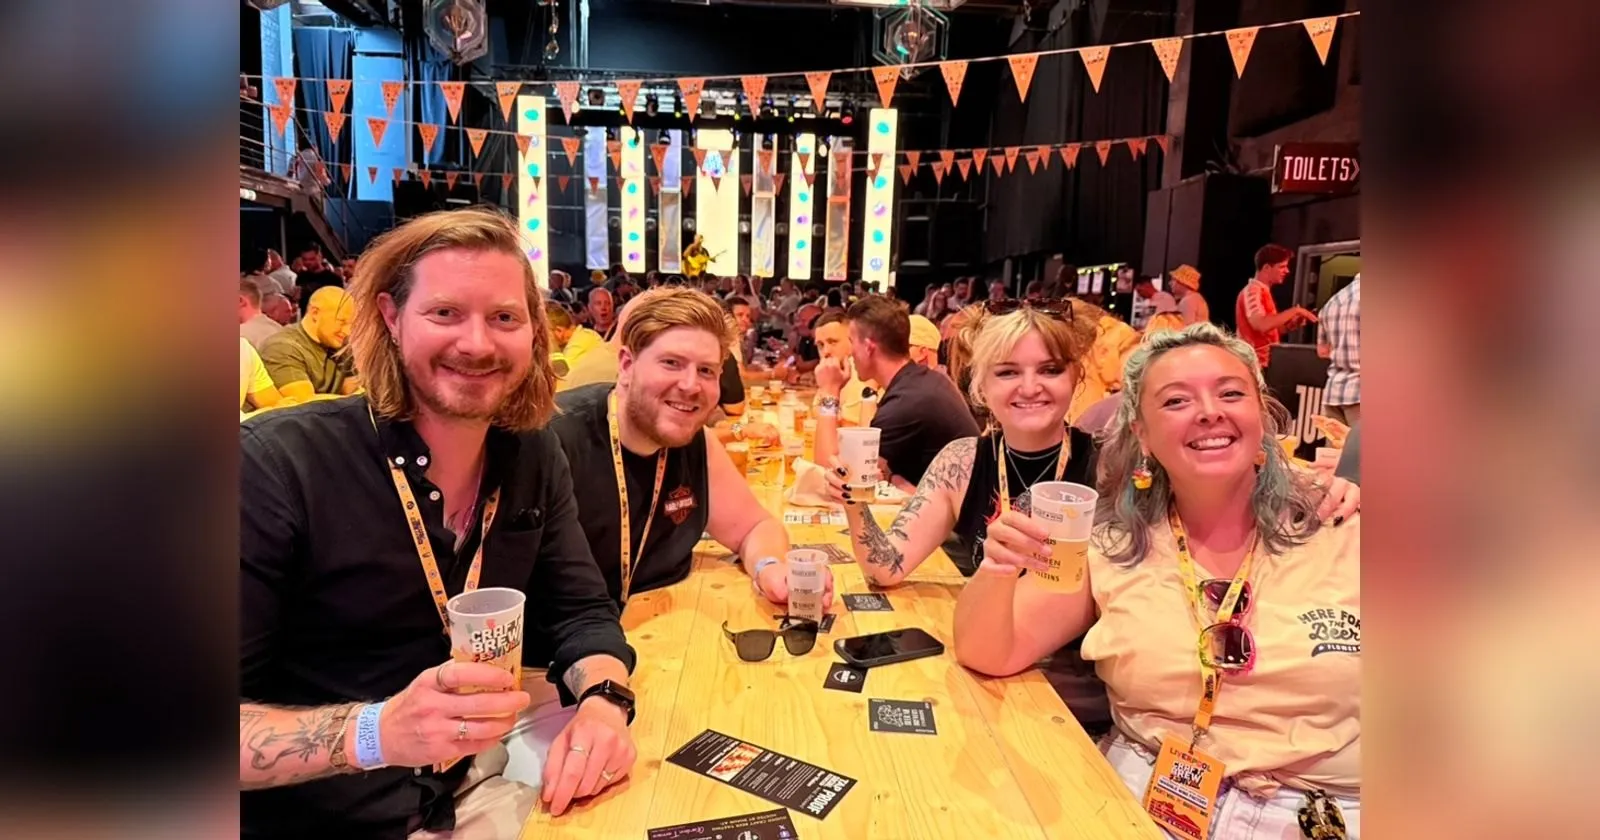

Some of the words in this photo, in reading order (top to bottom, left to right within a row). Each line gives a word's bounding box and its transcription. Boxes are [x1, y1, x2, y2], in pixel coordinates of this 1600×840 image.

[1283, 156, 1350, 181] TOILETS
[1292, 384, 1325, 446] JU
[472, 613, 522, 642] CRAFT
[1297, 608, 1336, 624] HERE
[1328, 620, 1345, 628] THE
[472, 625, 522, 653] BREW
[1308, 622, 1360, 641] Beer
[1169, 747, 1212, 772] LIVERPOOL
[833, 778, 850, 792] TAP
[807, 788, 837, 815] PROOF
